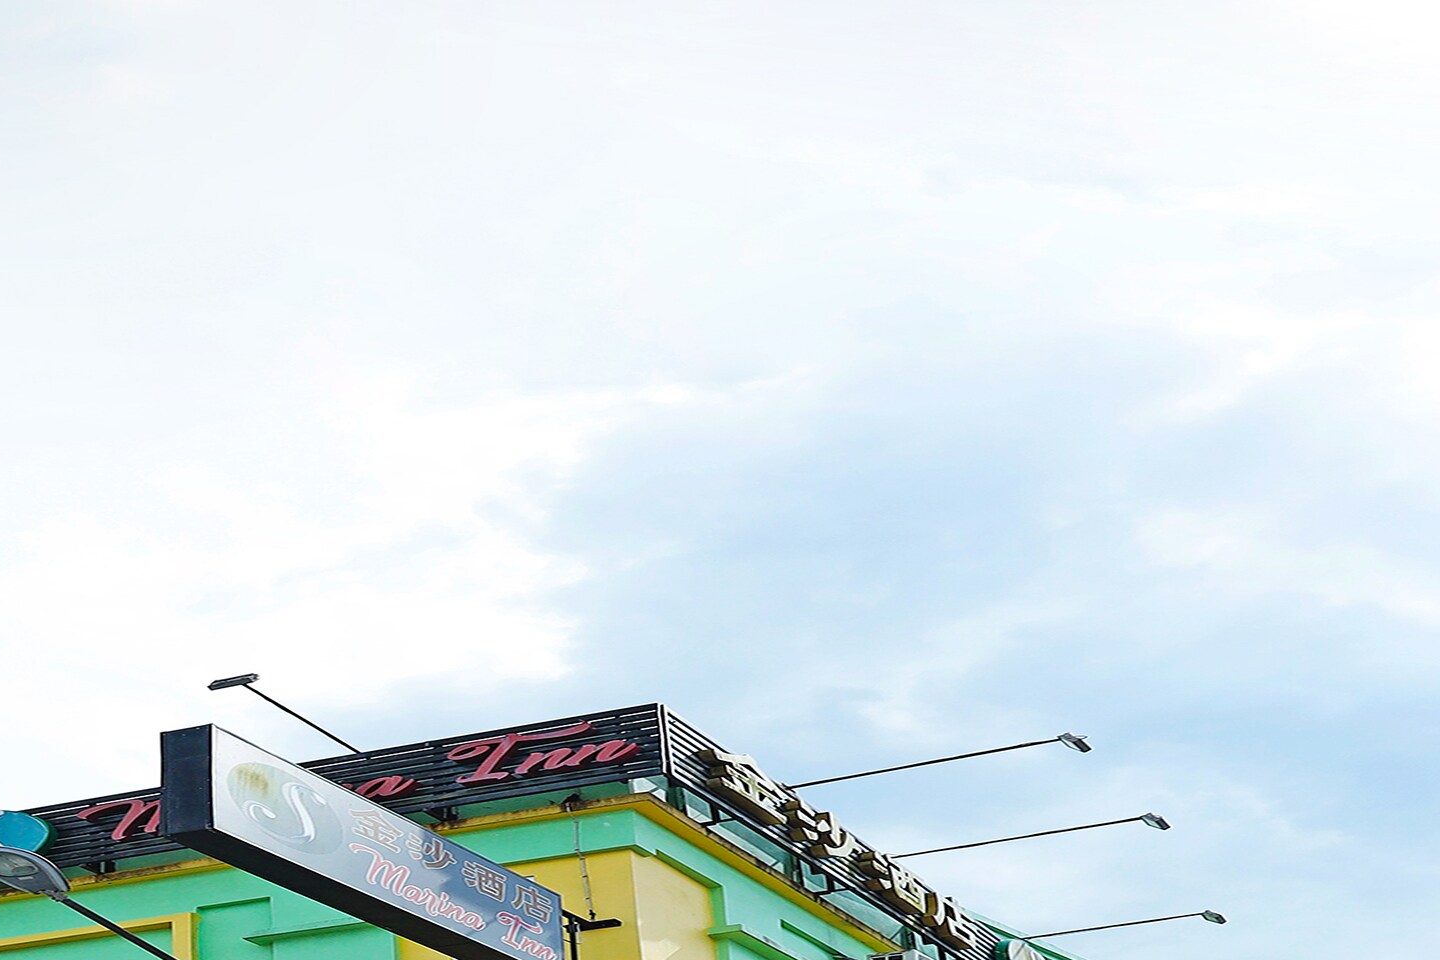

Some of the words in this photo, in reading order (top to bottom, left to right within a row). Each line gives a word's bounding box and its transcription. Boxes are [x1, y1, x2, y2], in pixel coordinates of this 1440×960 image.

[447, 719, 640, 785] Inn
[348, 842, 488, 932] Marina
[349, 808, 554, 924] 金沙酒店
